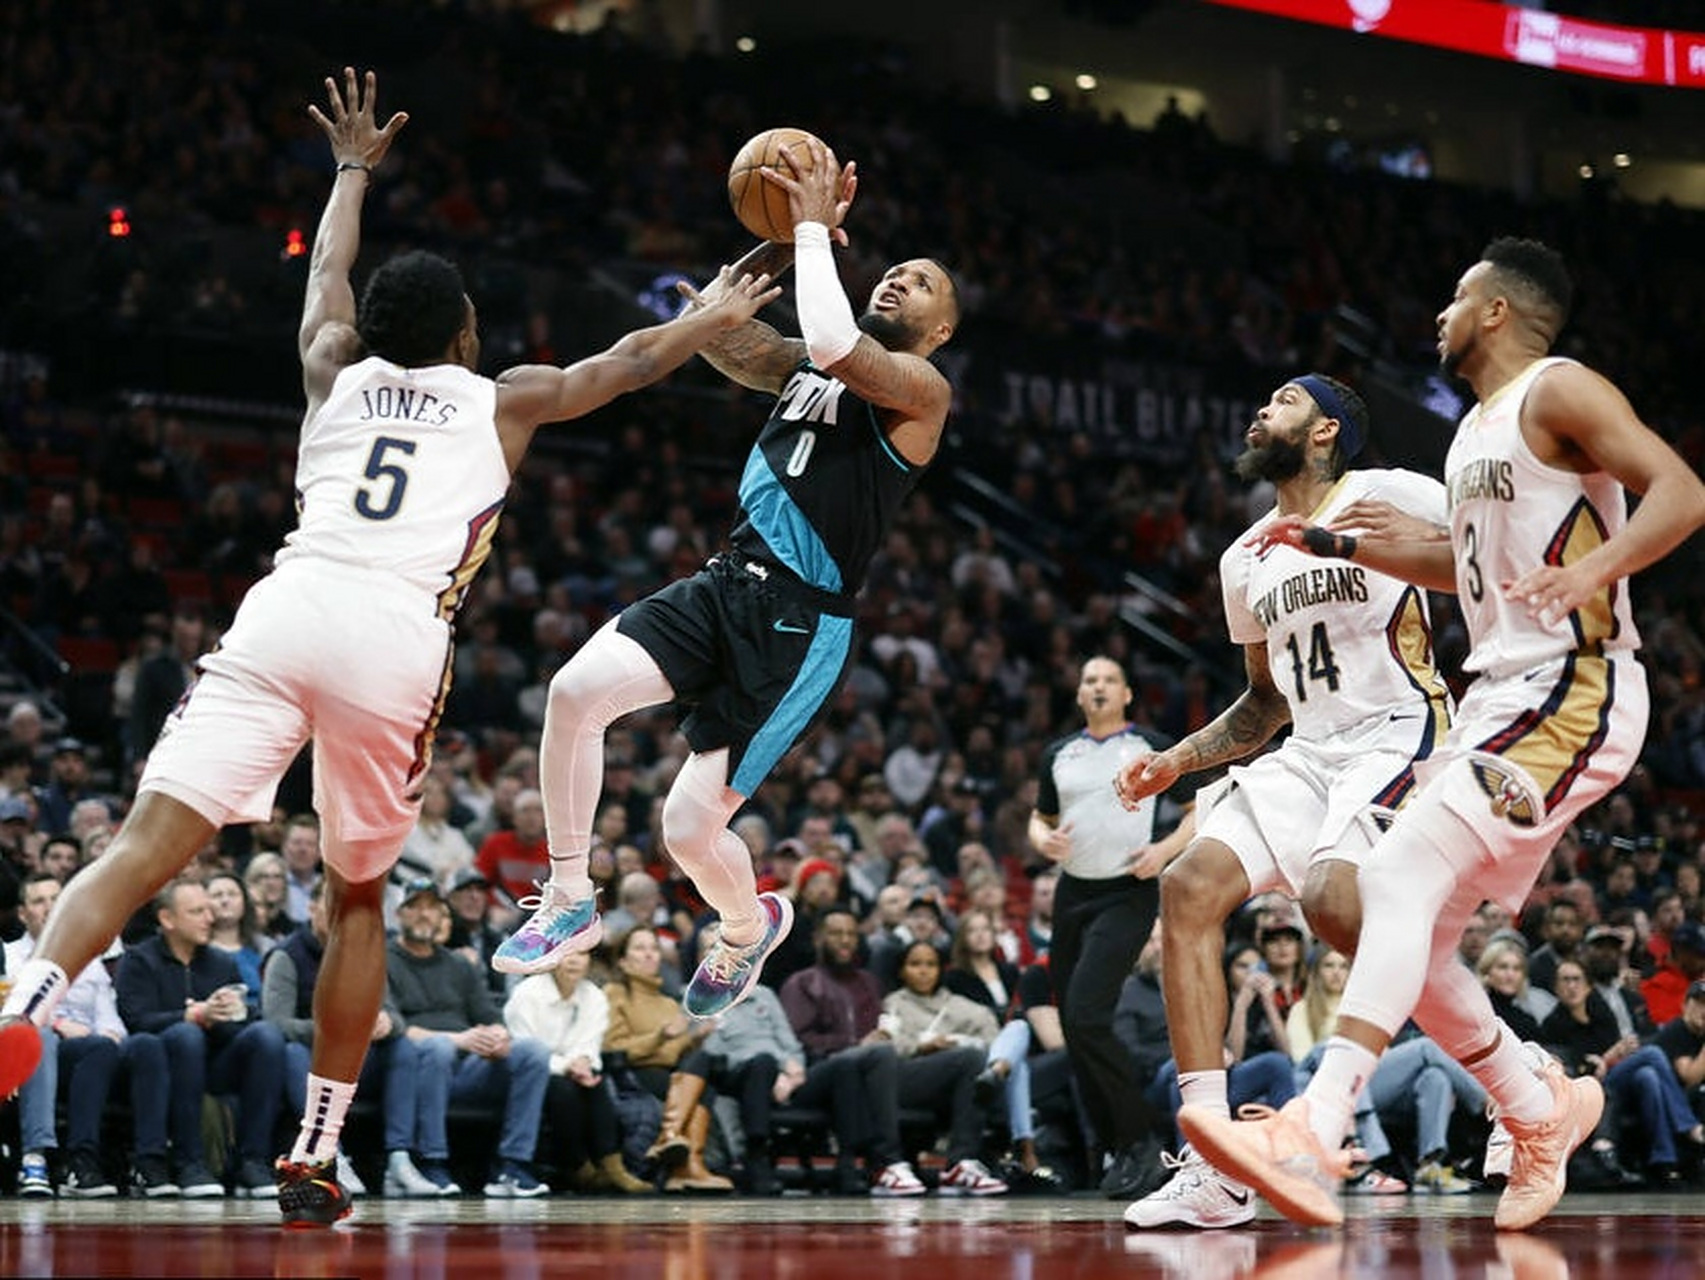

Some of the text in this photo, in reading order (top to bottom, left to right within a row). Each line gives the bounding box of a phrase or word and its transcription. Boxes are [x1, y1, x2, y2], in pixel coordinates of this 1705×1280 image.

[360, 386, 457, 426] JONES
[1004, 371, 1121, 437] TRAIL
[1136, 388, 1246, 448] BLAZE
[354, 435, 417, 522] 5
[786, 429, 816, 478] 0
[1282, 566, 1369, 614] ORLEANS
[1465, 522, 1484, 604] 3
[1287, 620, 1340, 703] 14
